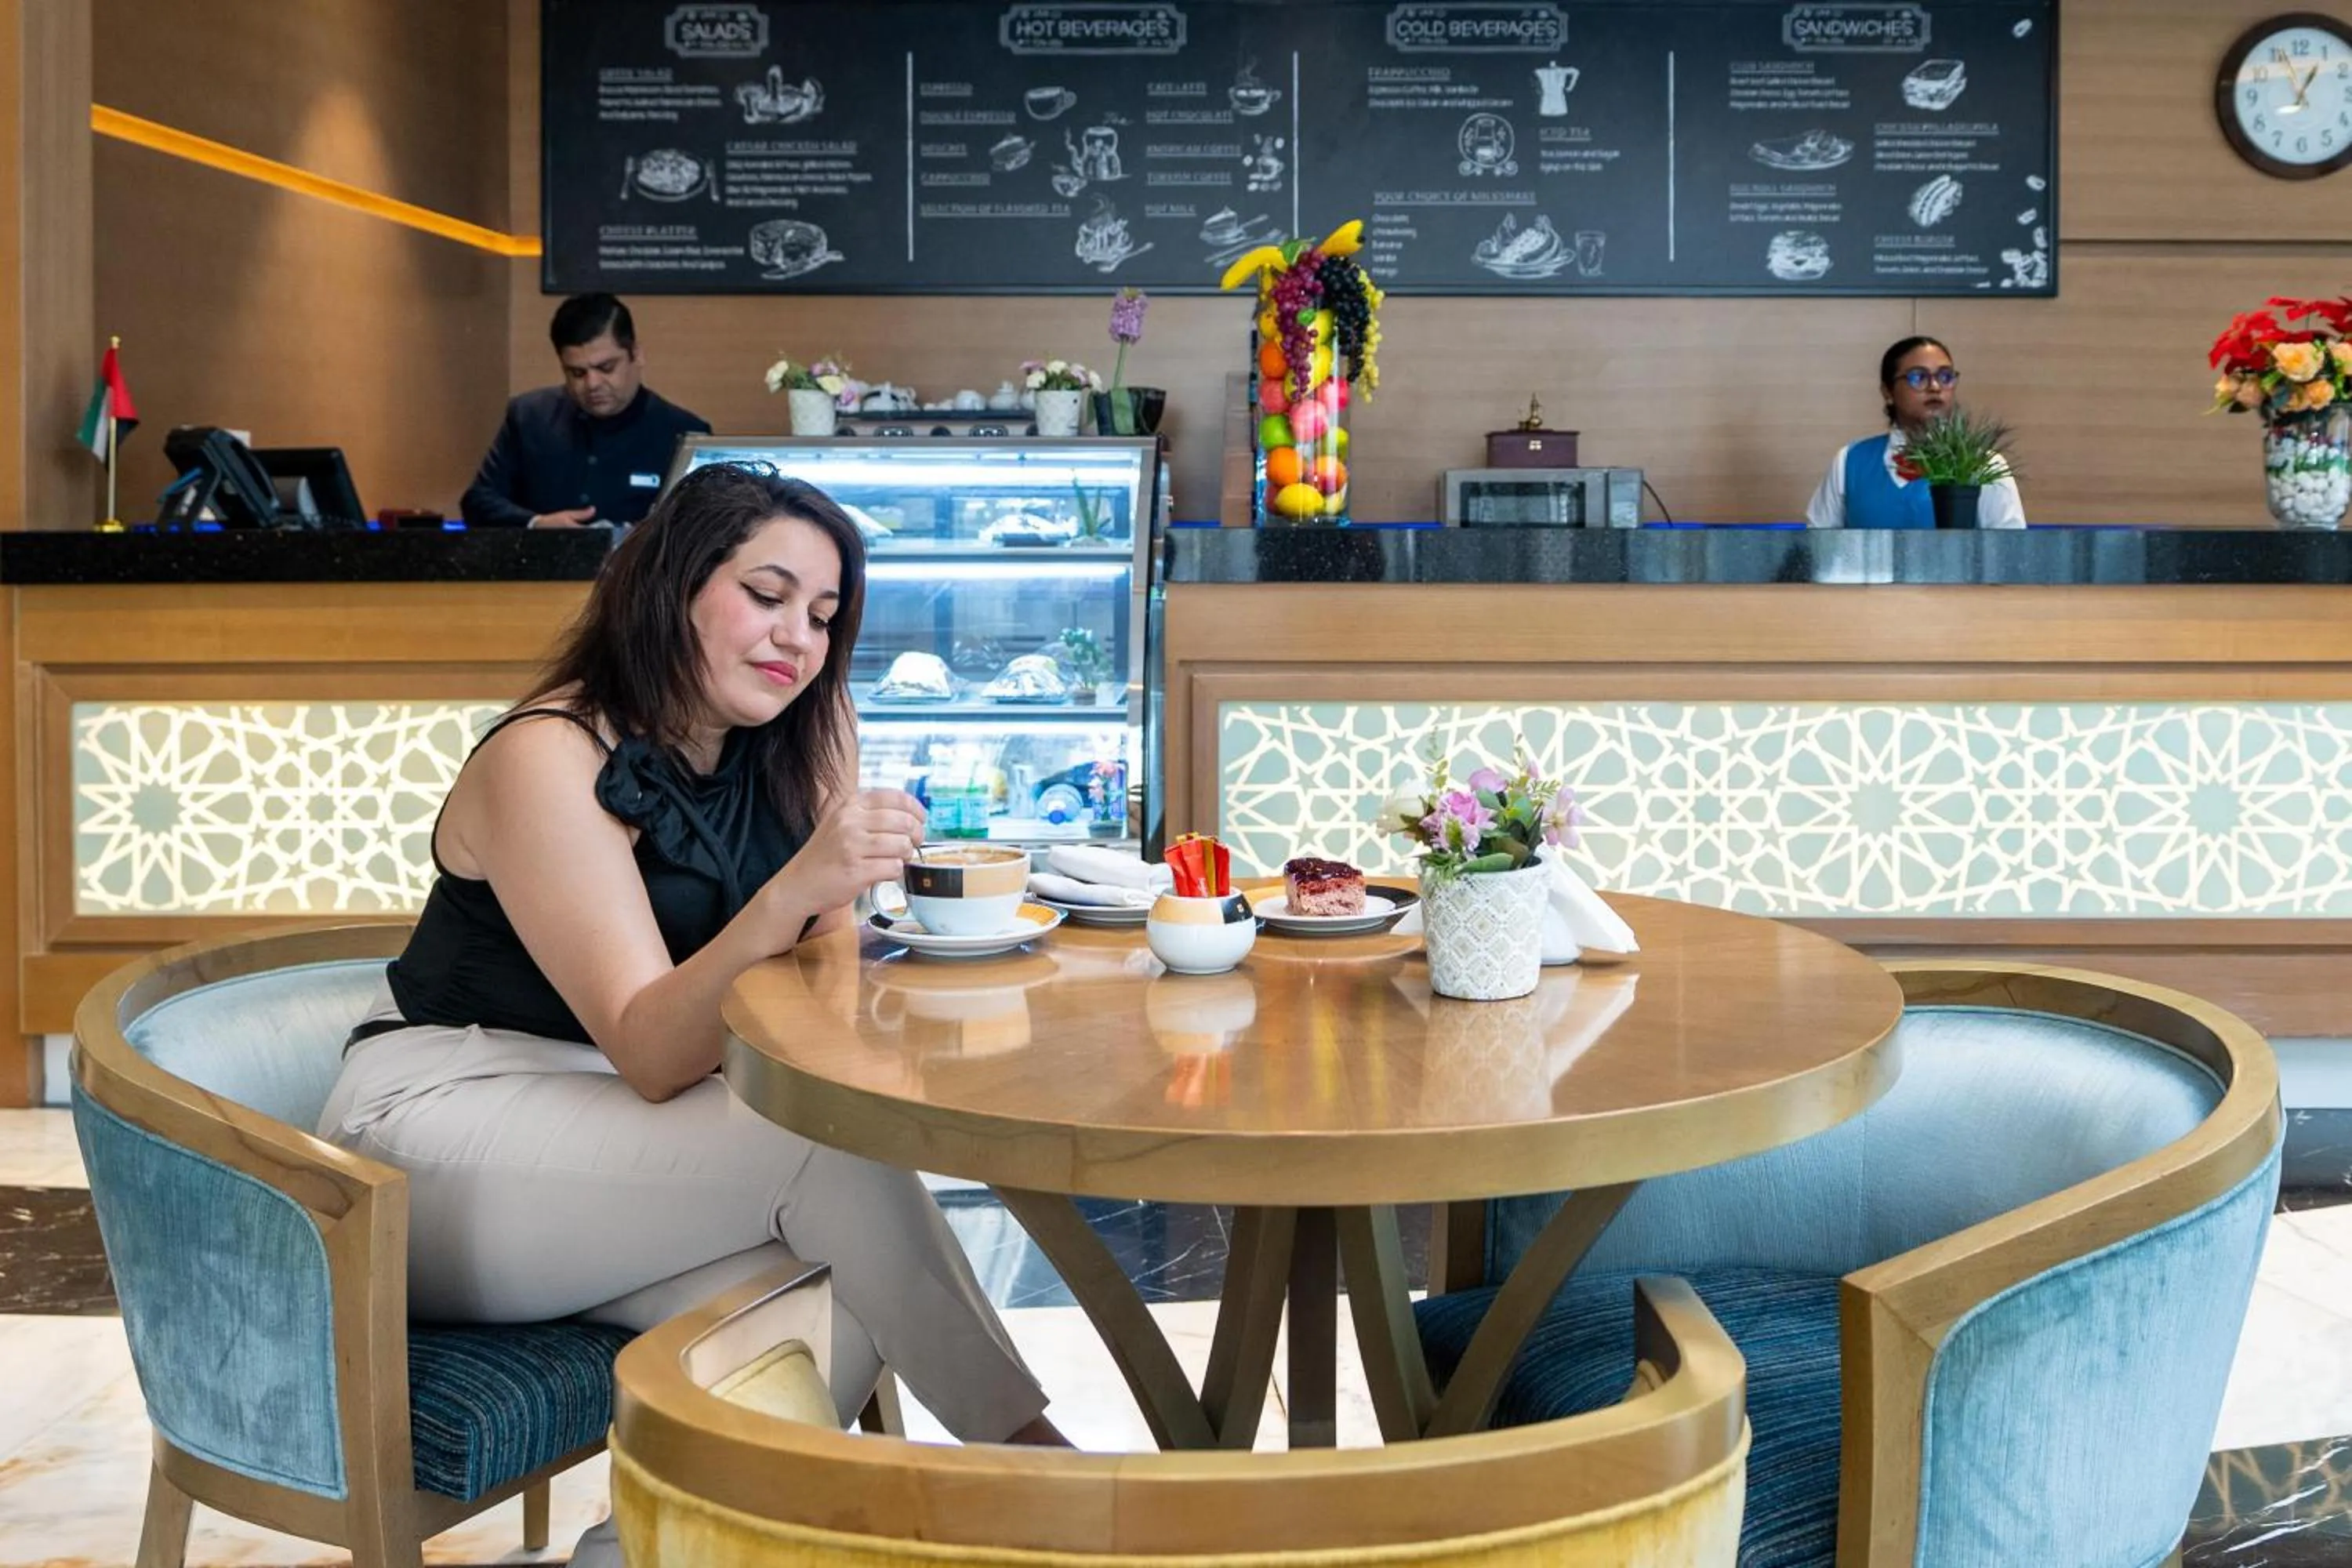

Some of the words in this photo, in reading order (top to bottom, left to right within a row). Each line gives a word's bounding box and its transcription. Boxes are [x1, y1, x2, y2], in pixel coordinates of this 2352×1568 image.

[681, 22, 753, 40] SALADS
[1015, 20, 1055, 37] HOT
[1059, 20, 1171, 37] BEVERAGES
[1396, 20, 1445, 37] COLD
[1450, 20, 1558, 37] BEVERAGES
[1794, 20, 1914, 36] SANDWICHES
[2292, 38, 2310, 56] 12
[2321, 45, 2328, 62] 1
[2252, 66, 2269, 83] 10
[2337, 62, 2349, 80] 2
[2245, 88, 2259, 107] 9
[2339, 111, 2349, 129] 4
[2271, 129, 2284, 148] 7
[2296, 136, 2309, 153] 6
[2321, 129, 2333, 147] 5
